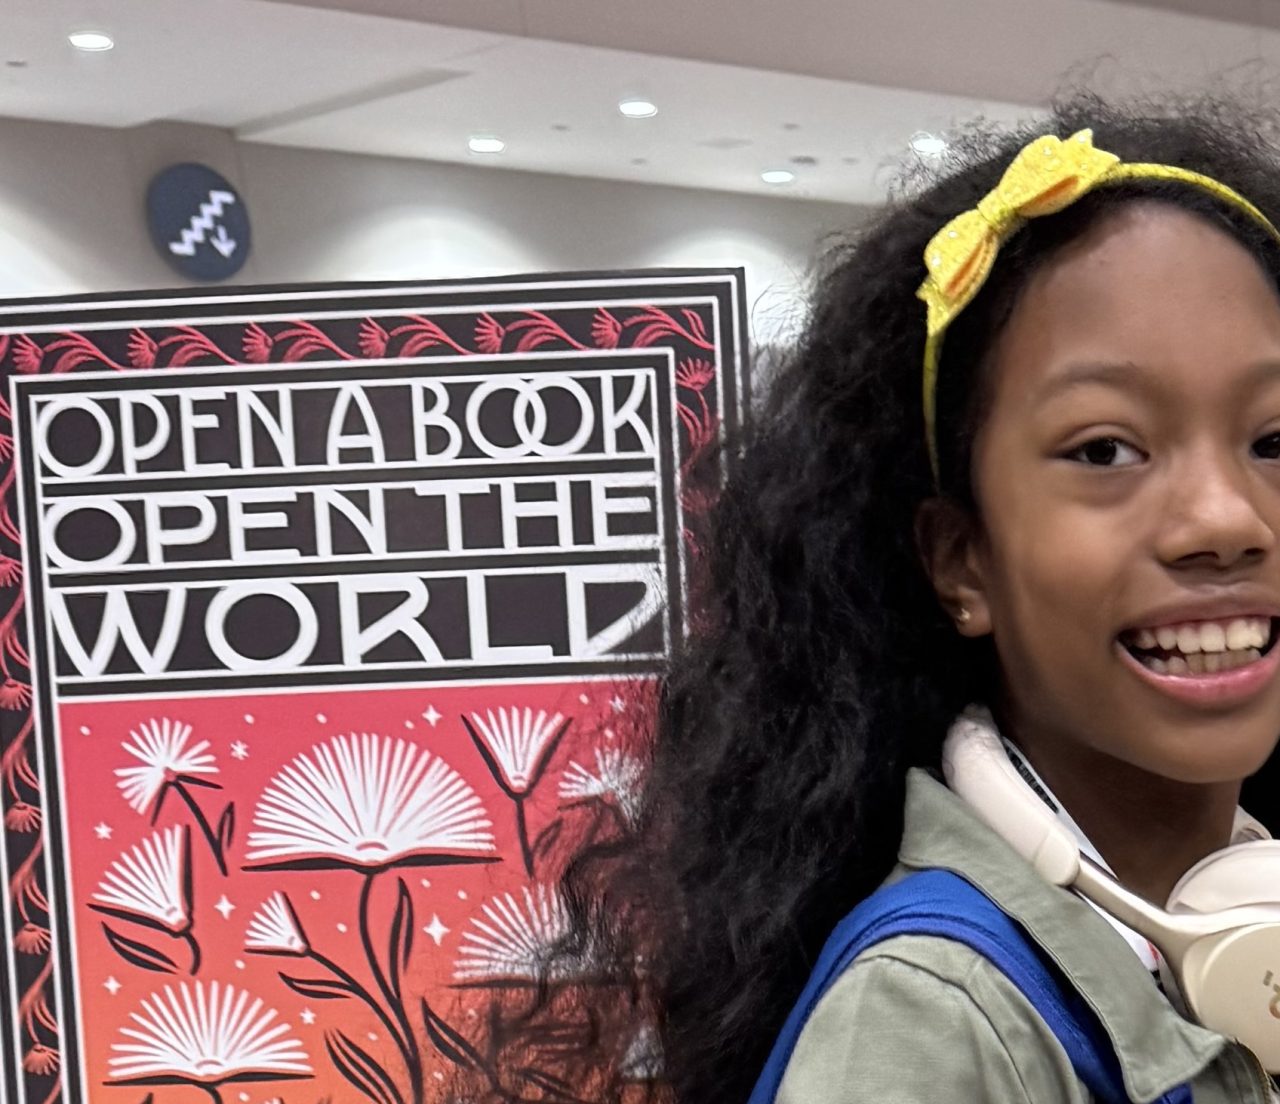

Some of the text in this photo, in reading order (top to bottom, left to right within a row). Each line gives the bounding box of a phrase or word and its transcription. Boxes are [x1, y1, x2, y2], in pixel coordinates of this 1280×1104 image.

[37, 372, 656, 477] OPEN A BOOK
[43, 475, 658, 570] OPEN THE
[47, 571, 664, 677] WORLD
